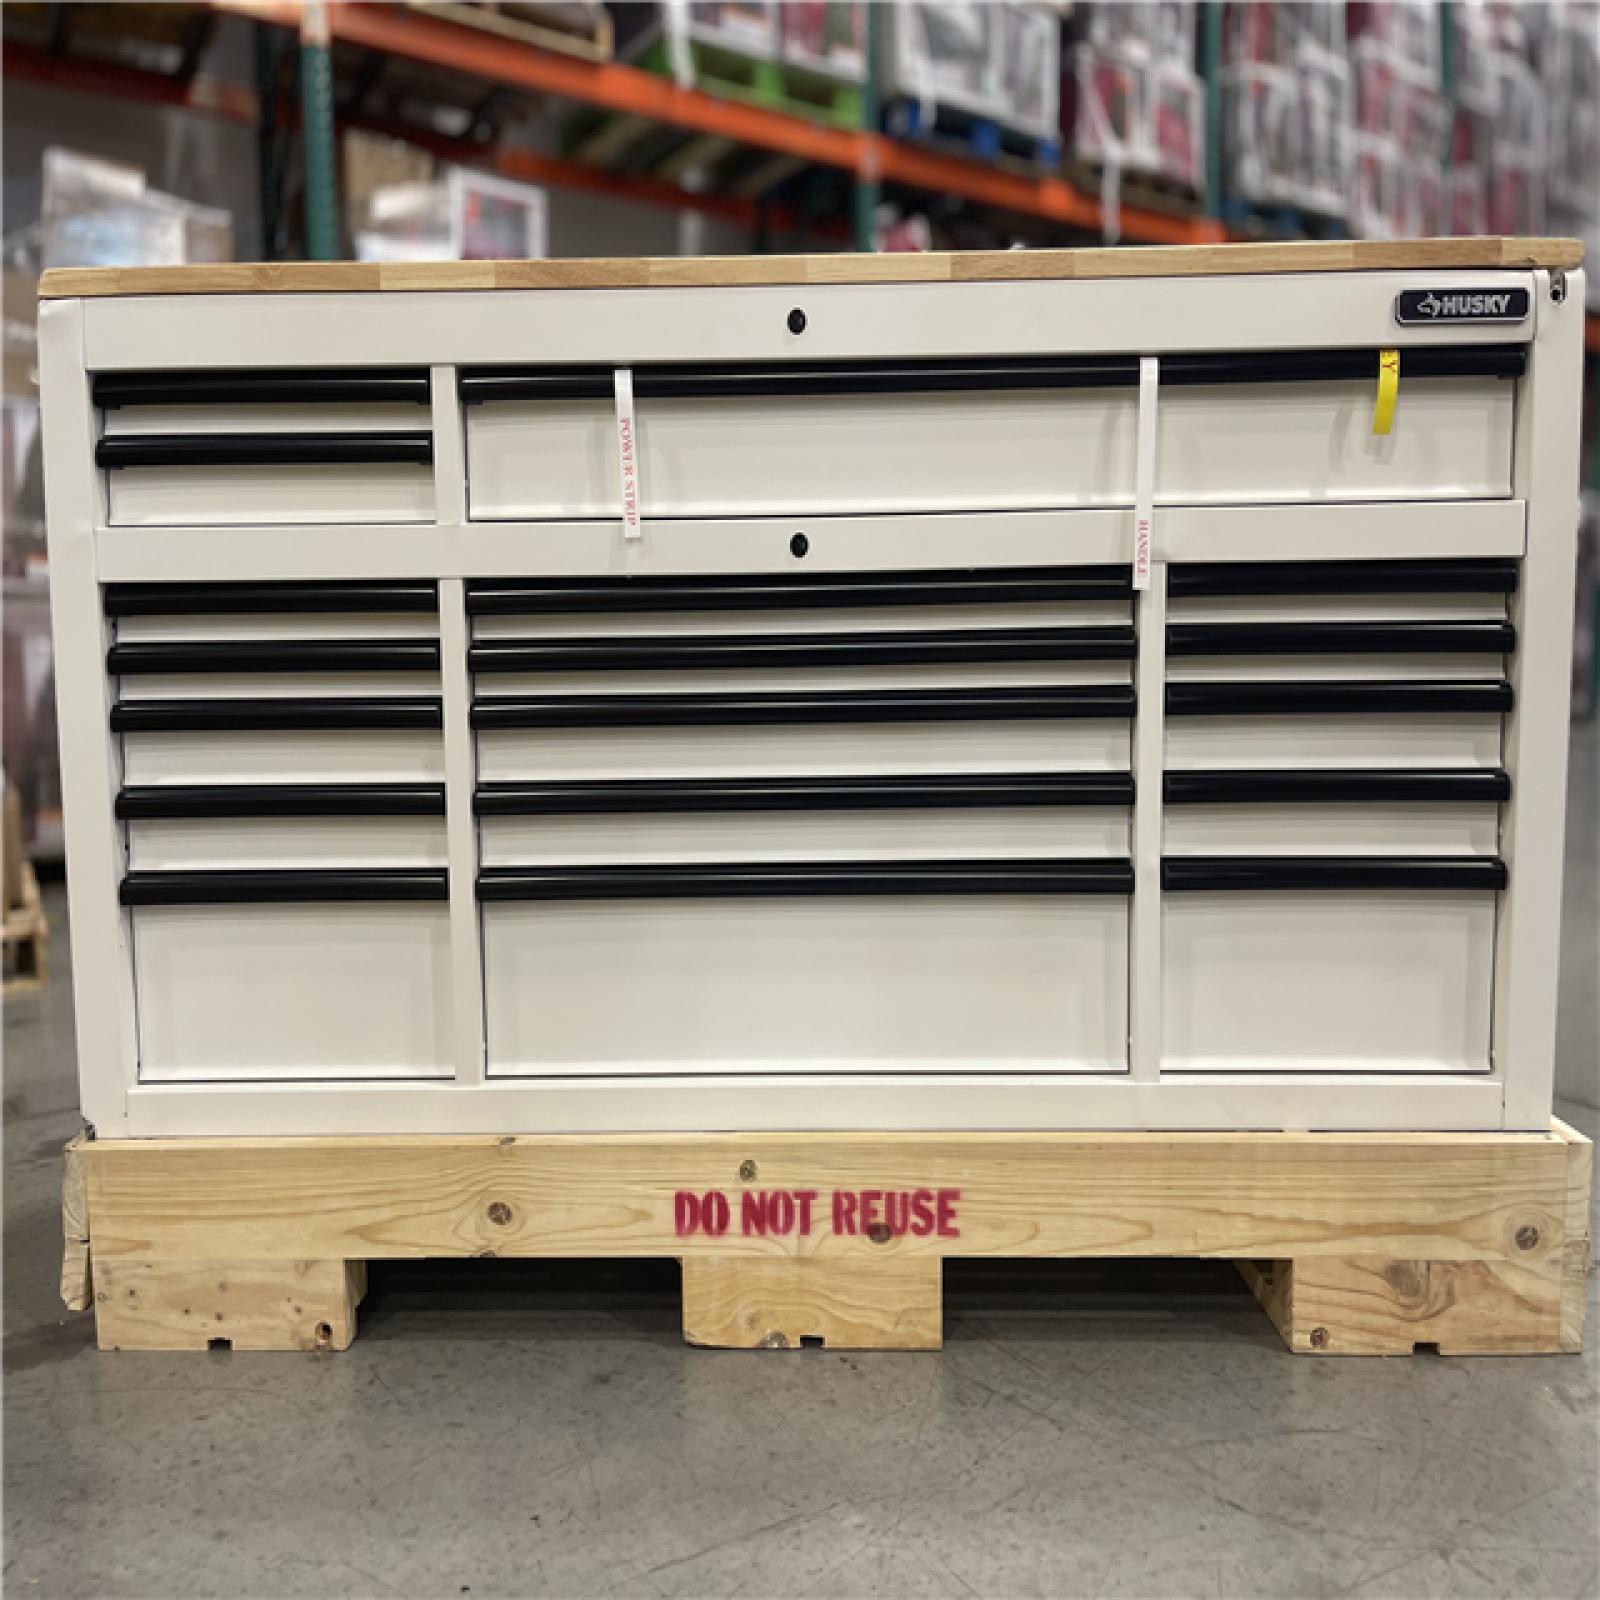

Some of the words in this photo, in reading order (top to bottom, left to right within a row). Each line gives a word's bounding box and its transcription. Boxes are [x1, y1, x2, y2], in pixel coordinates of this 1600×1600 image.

[1441, 294, 1511, 316] HUSKY
[674, 1189, 731, 1239] DO
[741, 1189, 818, 1237] NOT
[831, 1187, 962, 1239] REUSE
